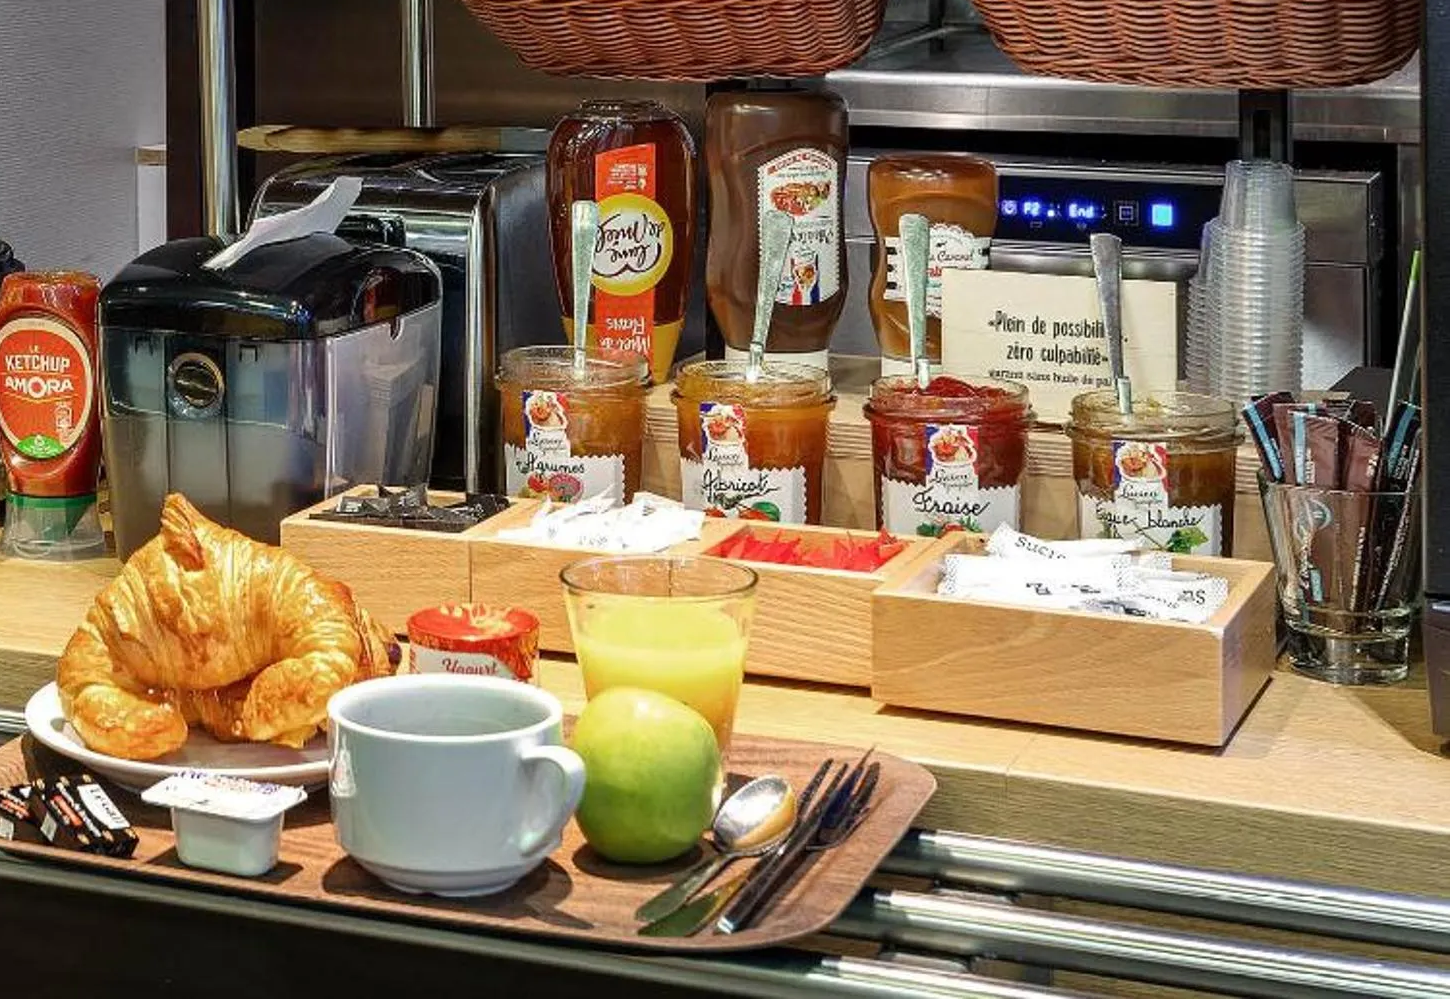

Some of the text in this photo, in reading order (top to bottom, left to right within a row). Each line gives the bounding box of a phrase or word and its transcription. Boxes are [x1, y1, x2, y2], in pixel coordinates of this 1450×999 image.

[1031, 316, 1047, 335] de
[5, 354, 71, 374] KETCHUP
[5, 375, 75, 399] AMORA
[702, 468, 771, 504] Abricot
[911, 485, 991, 517] Fraise
[1139, 508, 1204, 529] blanche
